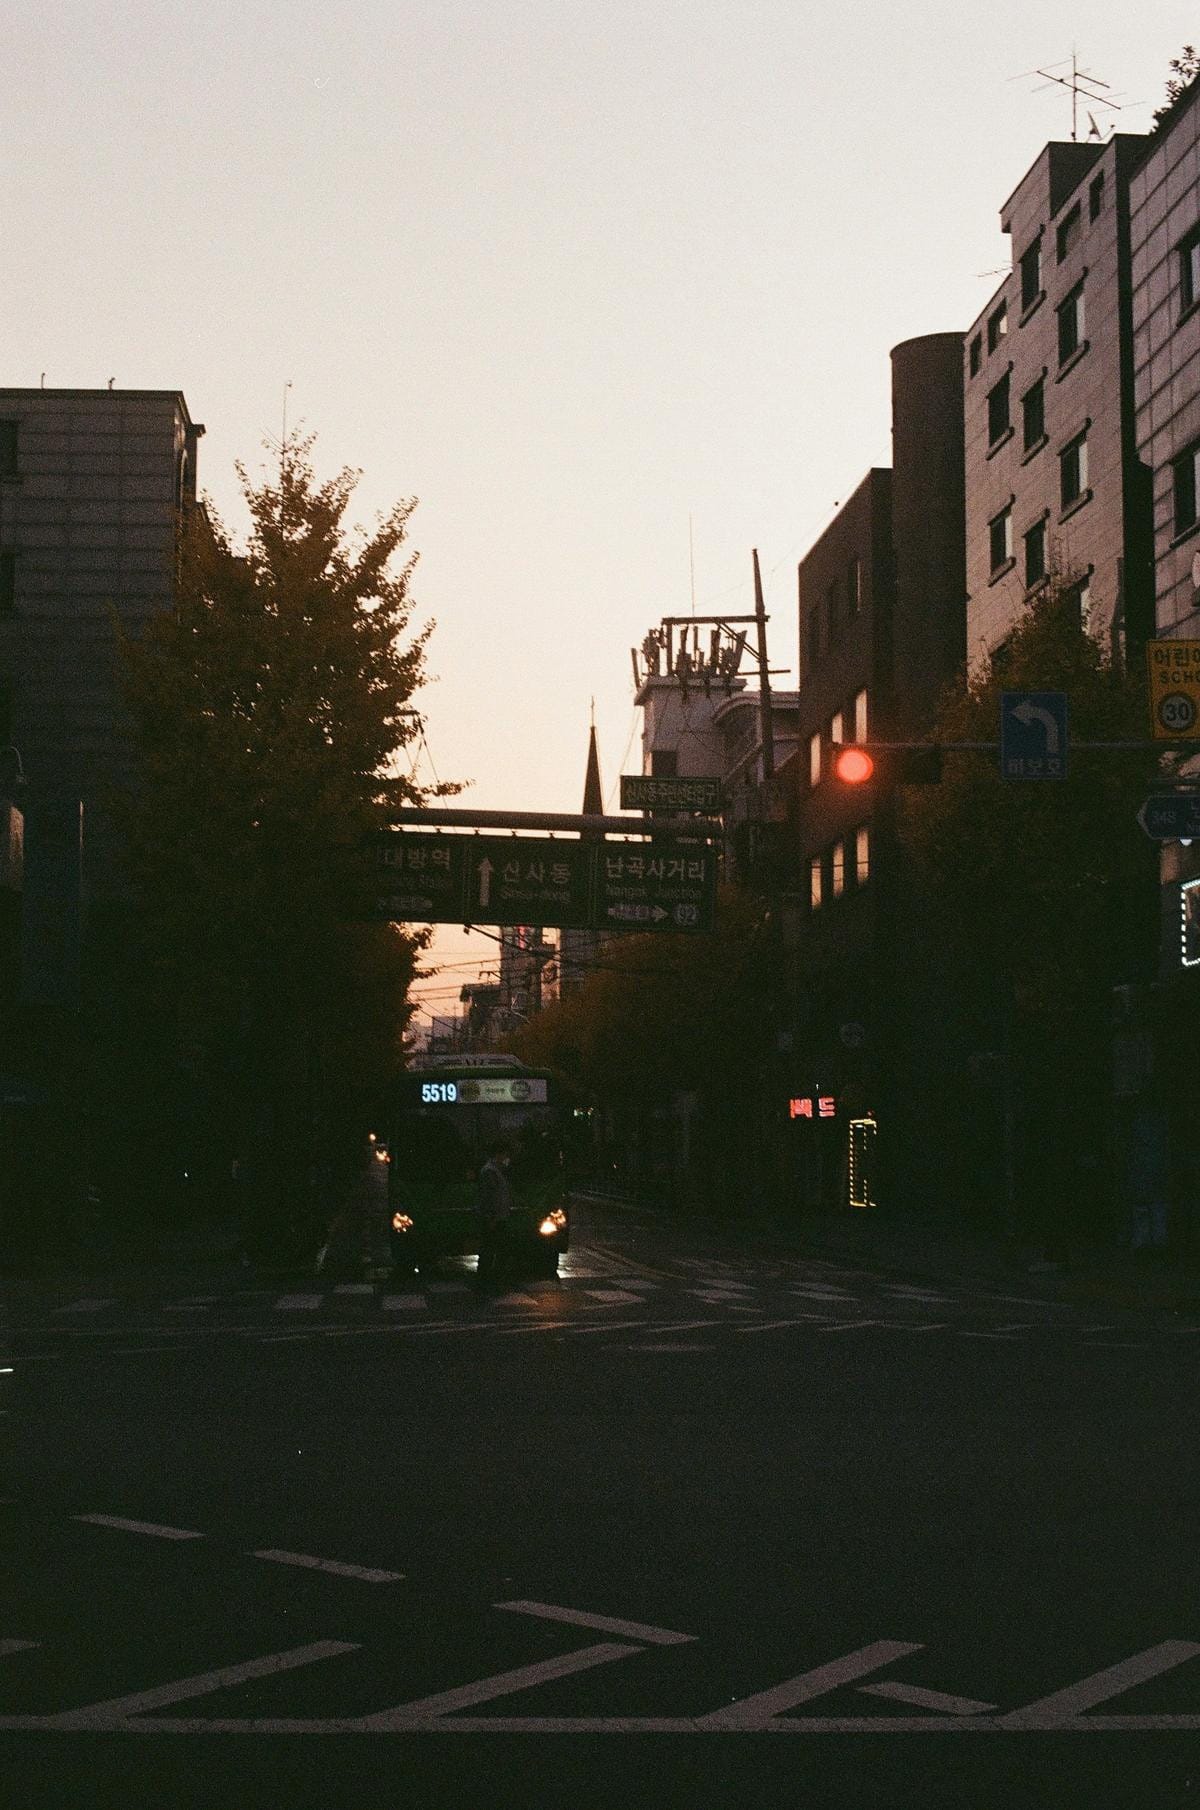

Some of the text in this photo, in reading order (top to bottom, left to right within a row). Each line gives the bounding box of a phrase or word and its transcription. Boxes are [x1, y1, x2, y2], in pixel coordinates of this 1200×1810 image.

[1165, 702, 1189, 721] 30
[1008, 758, 1061, 775] 비보호
[502, 859, 571, 884] 신사동
[606, 856, 706, 882] 난곡사거리
[421, 1083, 457, 1102] 5519
